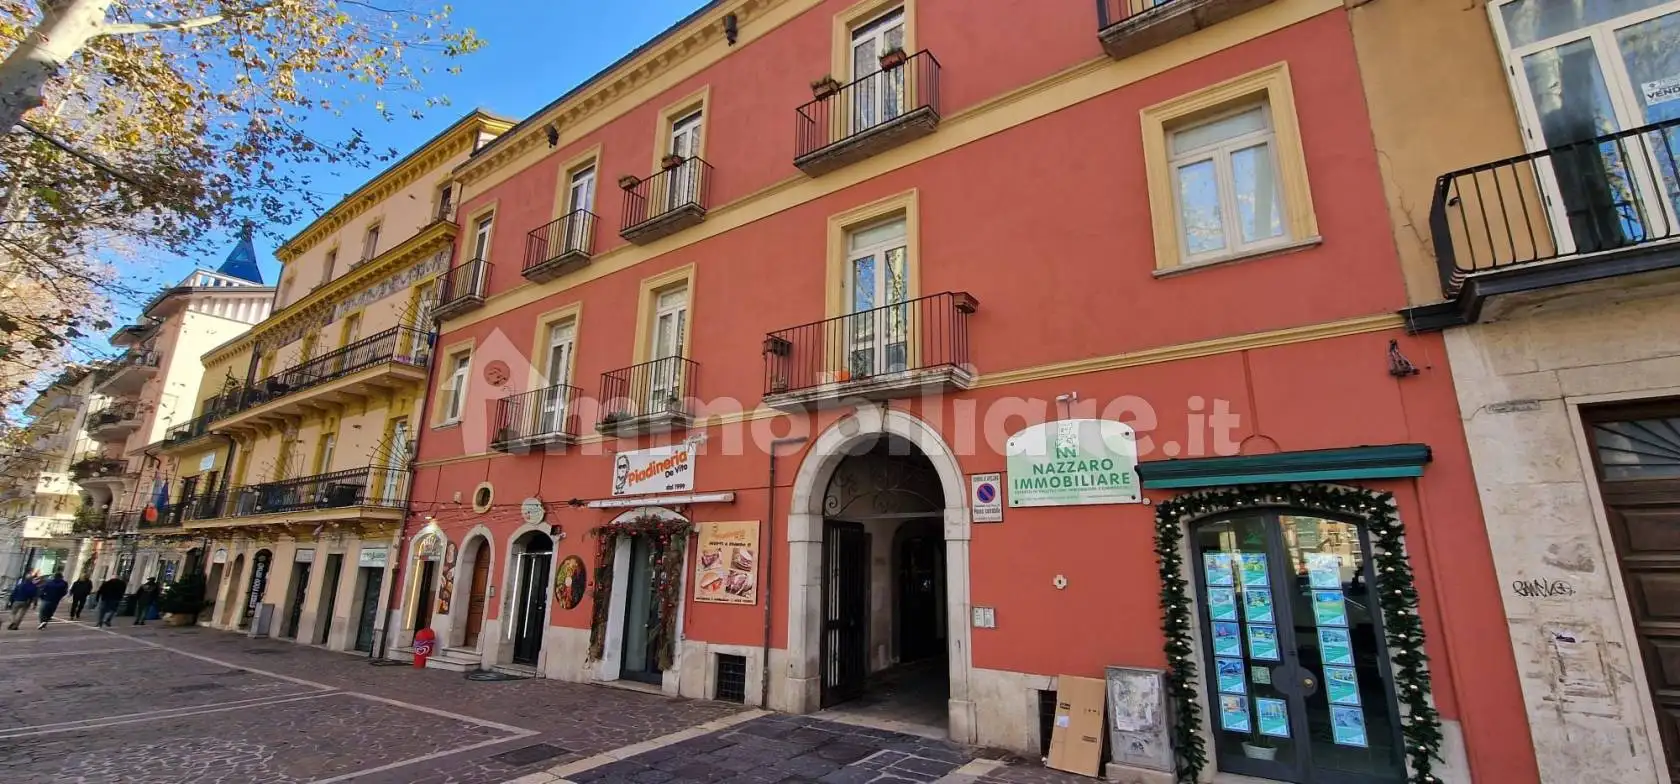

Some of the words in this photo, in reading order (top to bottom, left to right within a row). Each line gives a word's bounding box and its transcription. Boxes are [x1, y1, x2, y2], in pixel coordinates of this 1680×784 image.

[627, 450, 688, 487] Piadineria
[675, 463, 688, 475] Vito
[1033, 458, 1114, 475] NAZZARO
[1014, 472, 1131, 490] IMMOBILIARE
